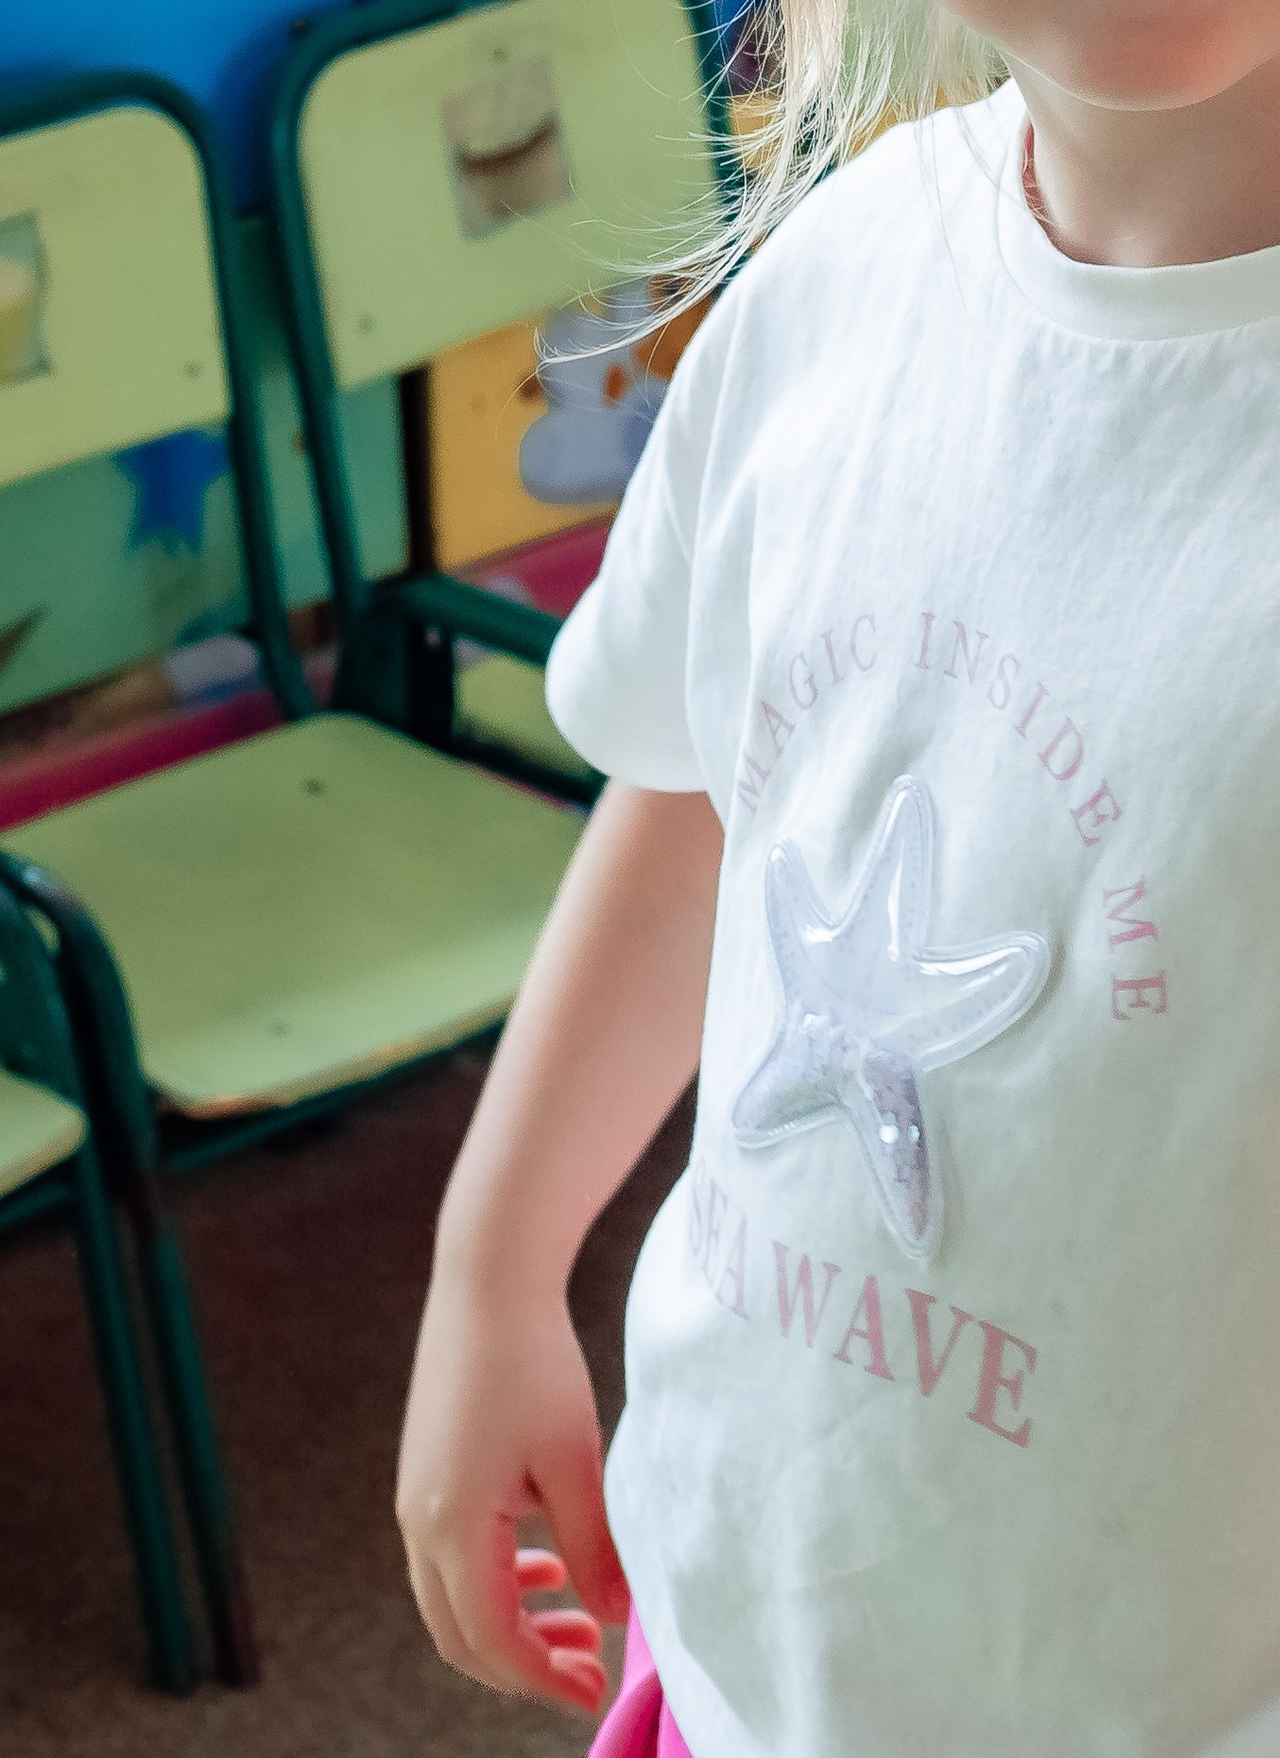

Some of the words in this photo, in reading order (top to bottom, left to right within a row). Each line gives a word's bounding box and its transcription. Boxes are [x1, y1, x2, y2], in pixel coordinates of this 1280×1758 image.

[735, 613, 877, 819] MAGIC
[914, 611, 1123, 847] INSIDE
[1102, 876, 1169, 1022] ME
[689, 1155, 751, 1322] SEA
[772, 1239, 1038, 1449] WAVE
